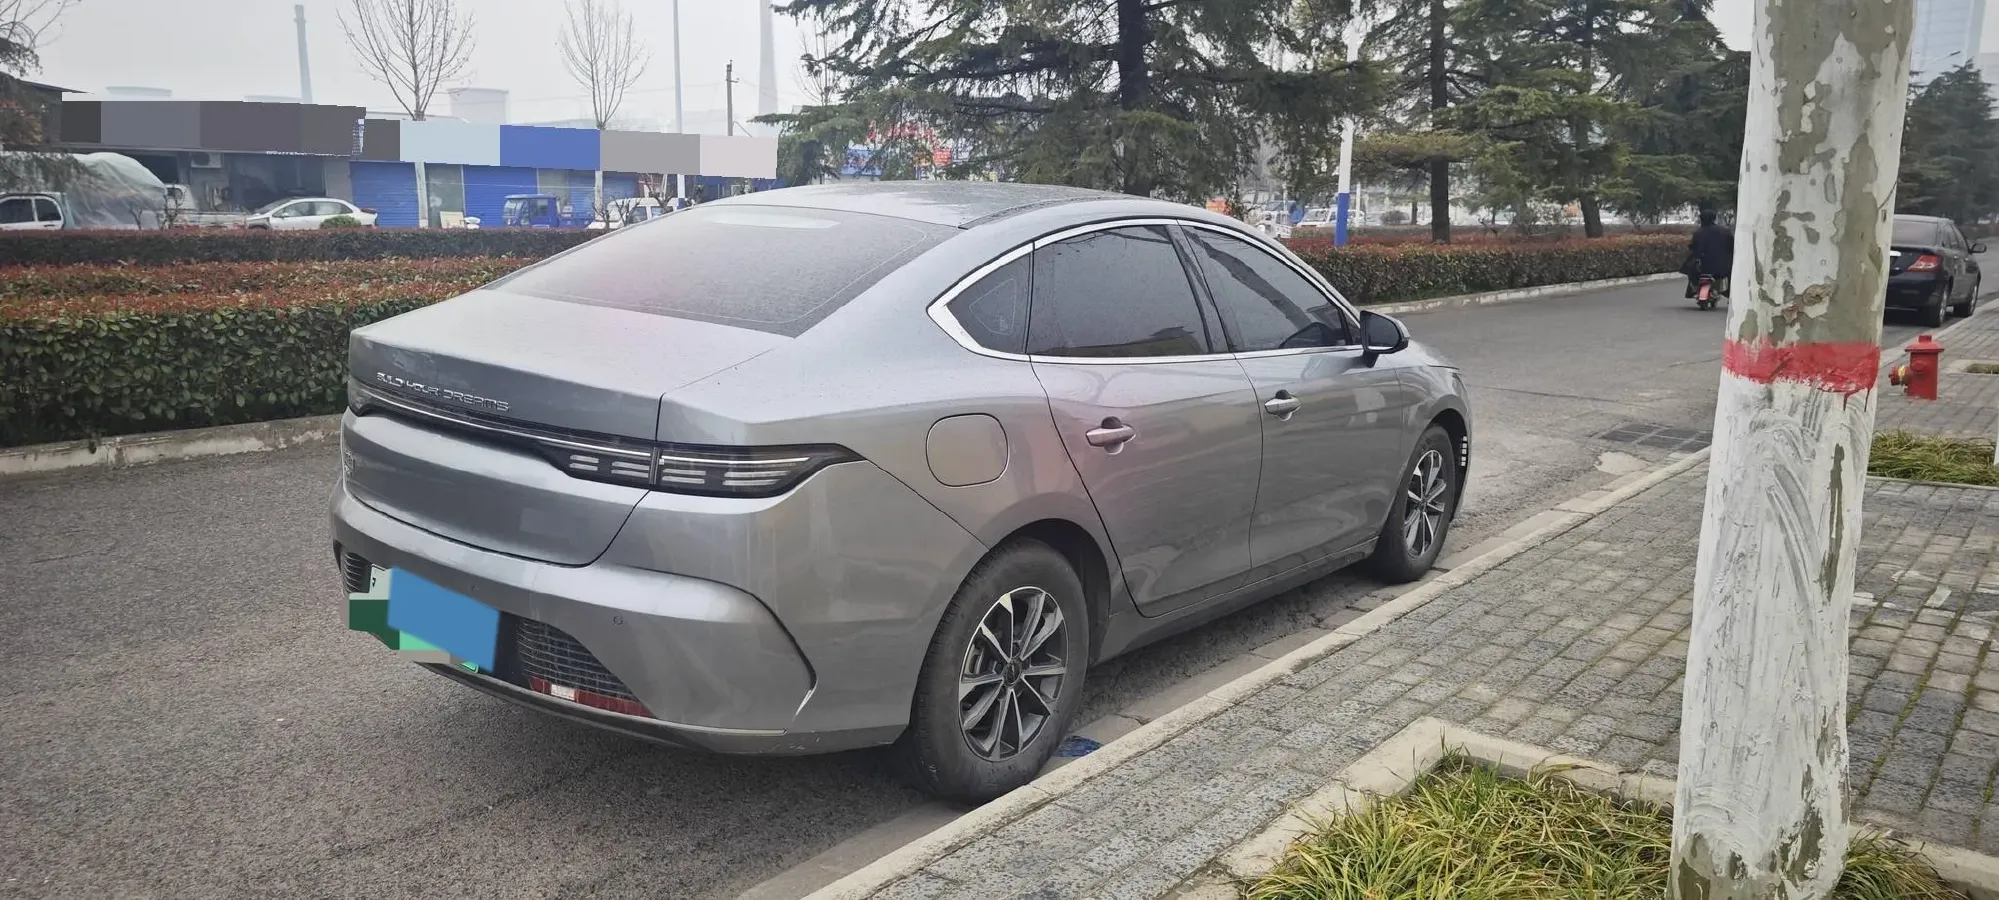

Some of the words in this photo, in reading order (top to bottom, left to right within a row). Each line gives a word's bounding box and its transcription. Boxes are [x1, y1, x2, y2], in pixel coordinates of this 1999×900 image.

[376, 371, 405, 387] BUILD
[405, 379, 439, 397] YOUR
[443, 388, 509, 412] DREAMS
